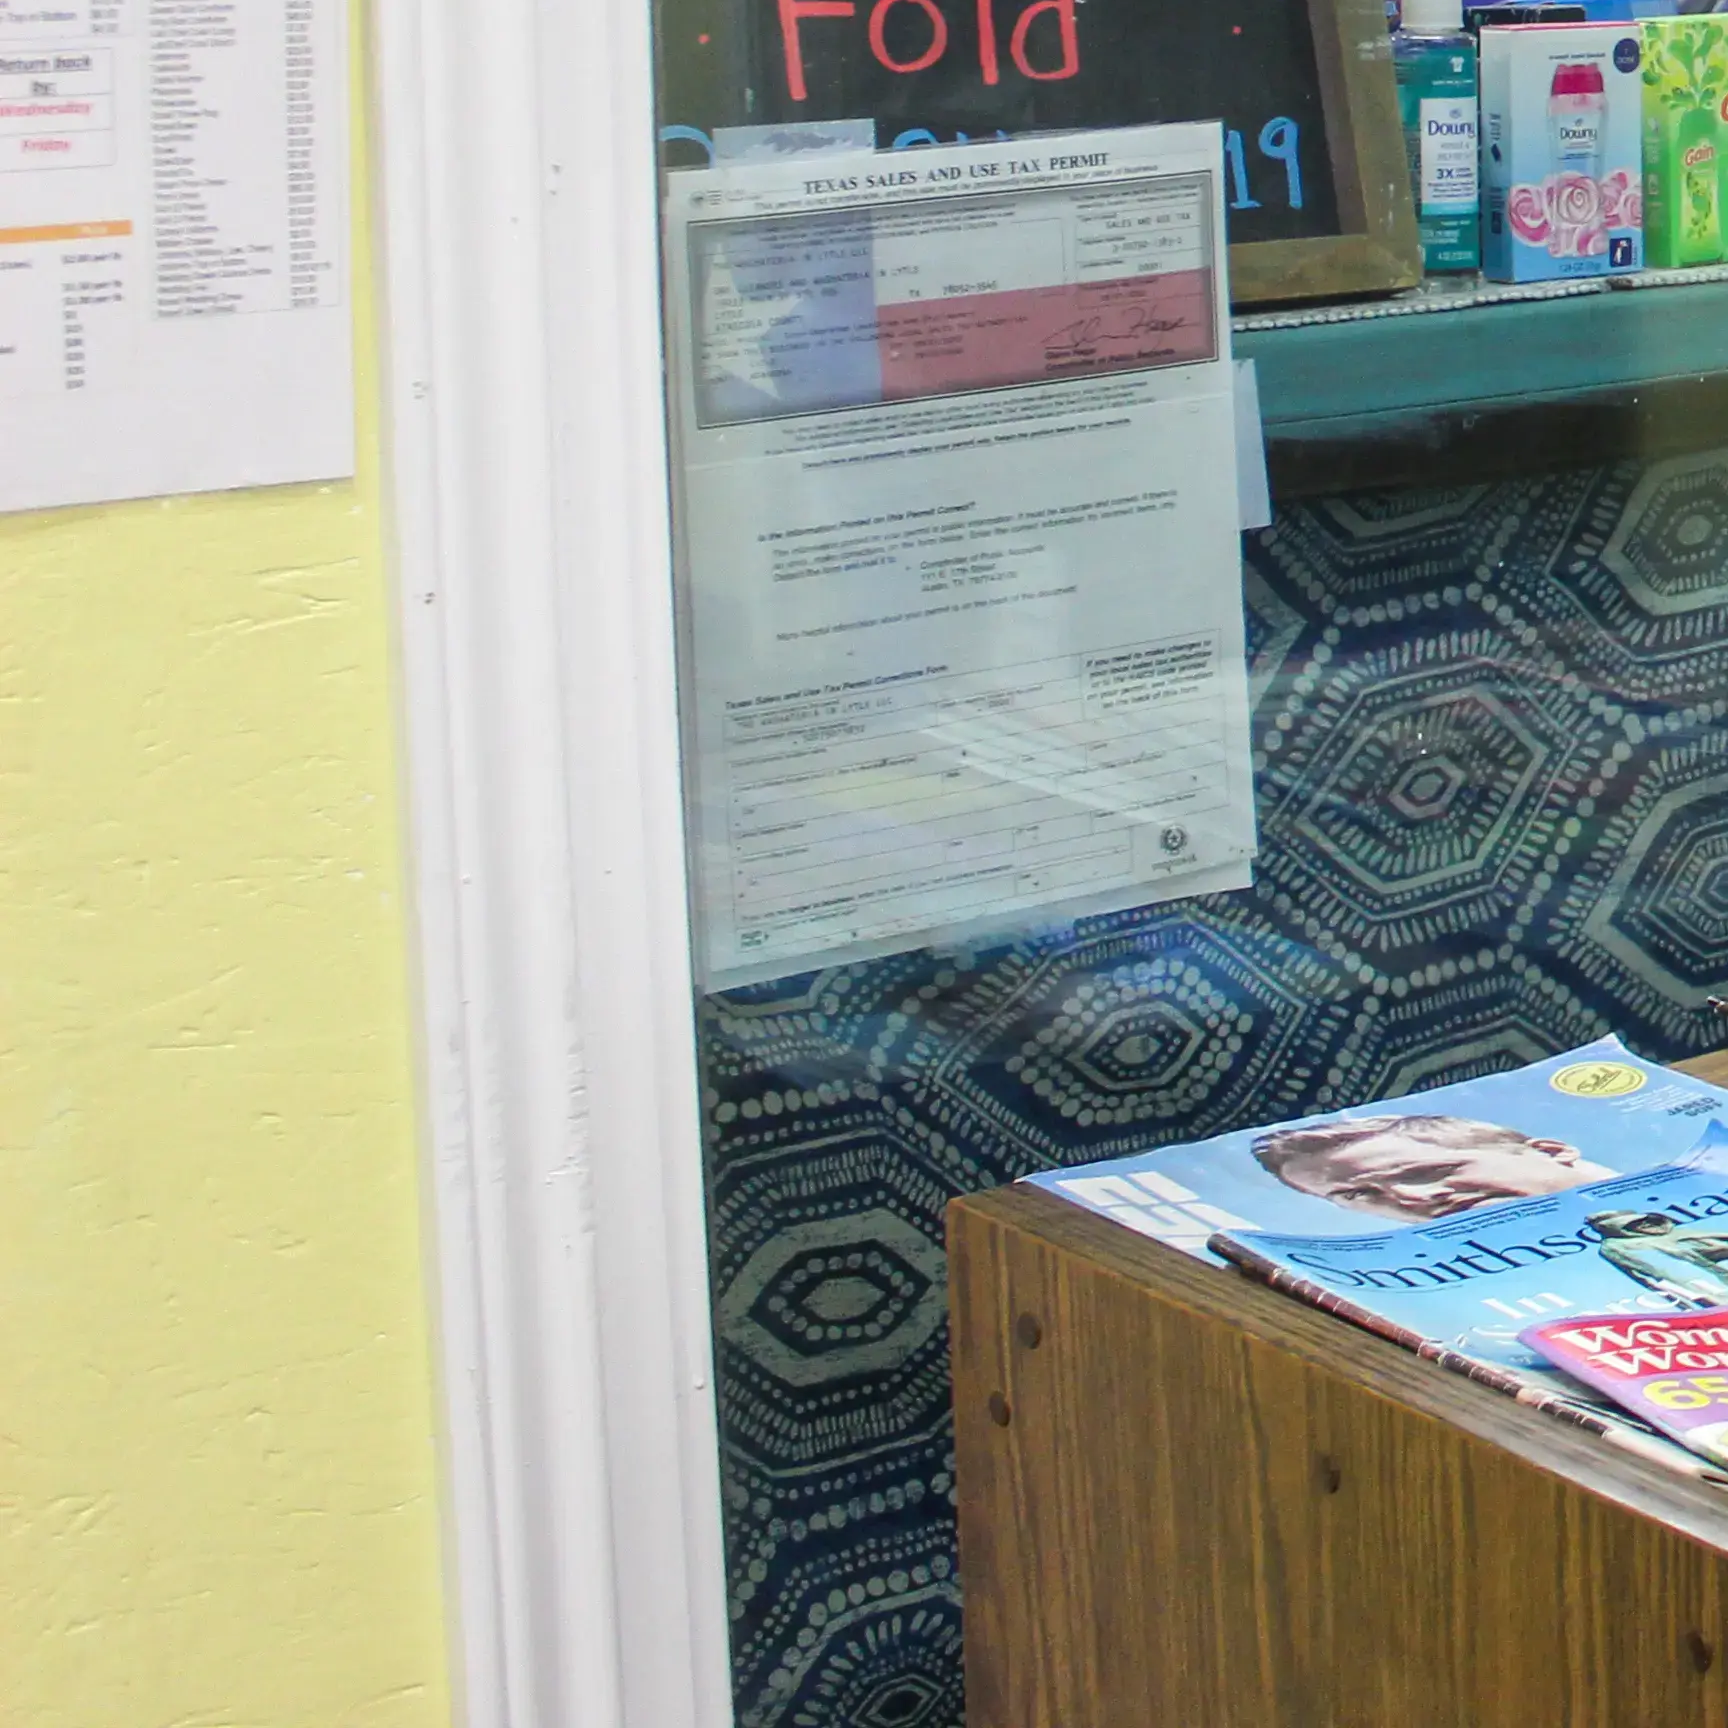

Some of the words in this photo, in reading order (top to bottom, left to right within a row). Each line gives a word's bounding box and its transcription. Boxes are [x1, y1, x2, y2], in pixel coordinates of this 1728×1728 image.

[1427, 119, 1477, 139] Downy
[1560, 126, 1598, 143] Downy
[1684, 144, 1716, 167] Gain
[803, 176, 858, 196] TEXAS
[866, 170, 918, 189] SALES
[926, 165, 962, 183] AND
[968, 161, 1001, 179] USE
[1006, 158, 1042, 175] TAX
[1049, 151, 1110, 171] PERMIT
[1480, 1290, 1576, 1320] In
